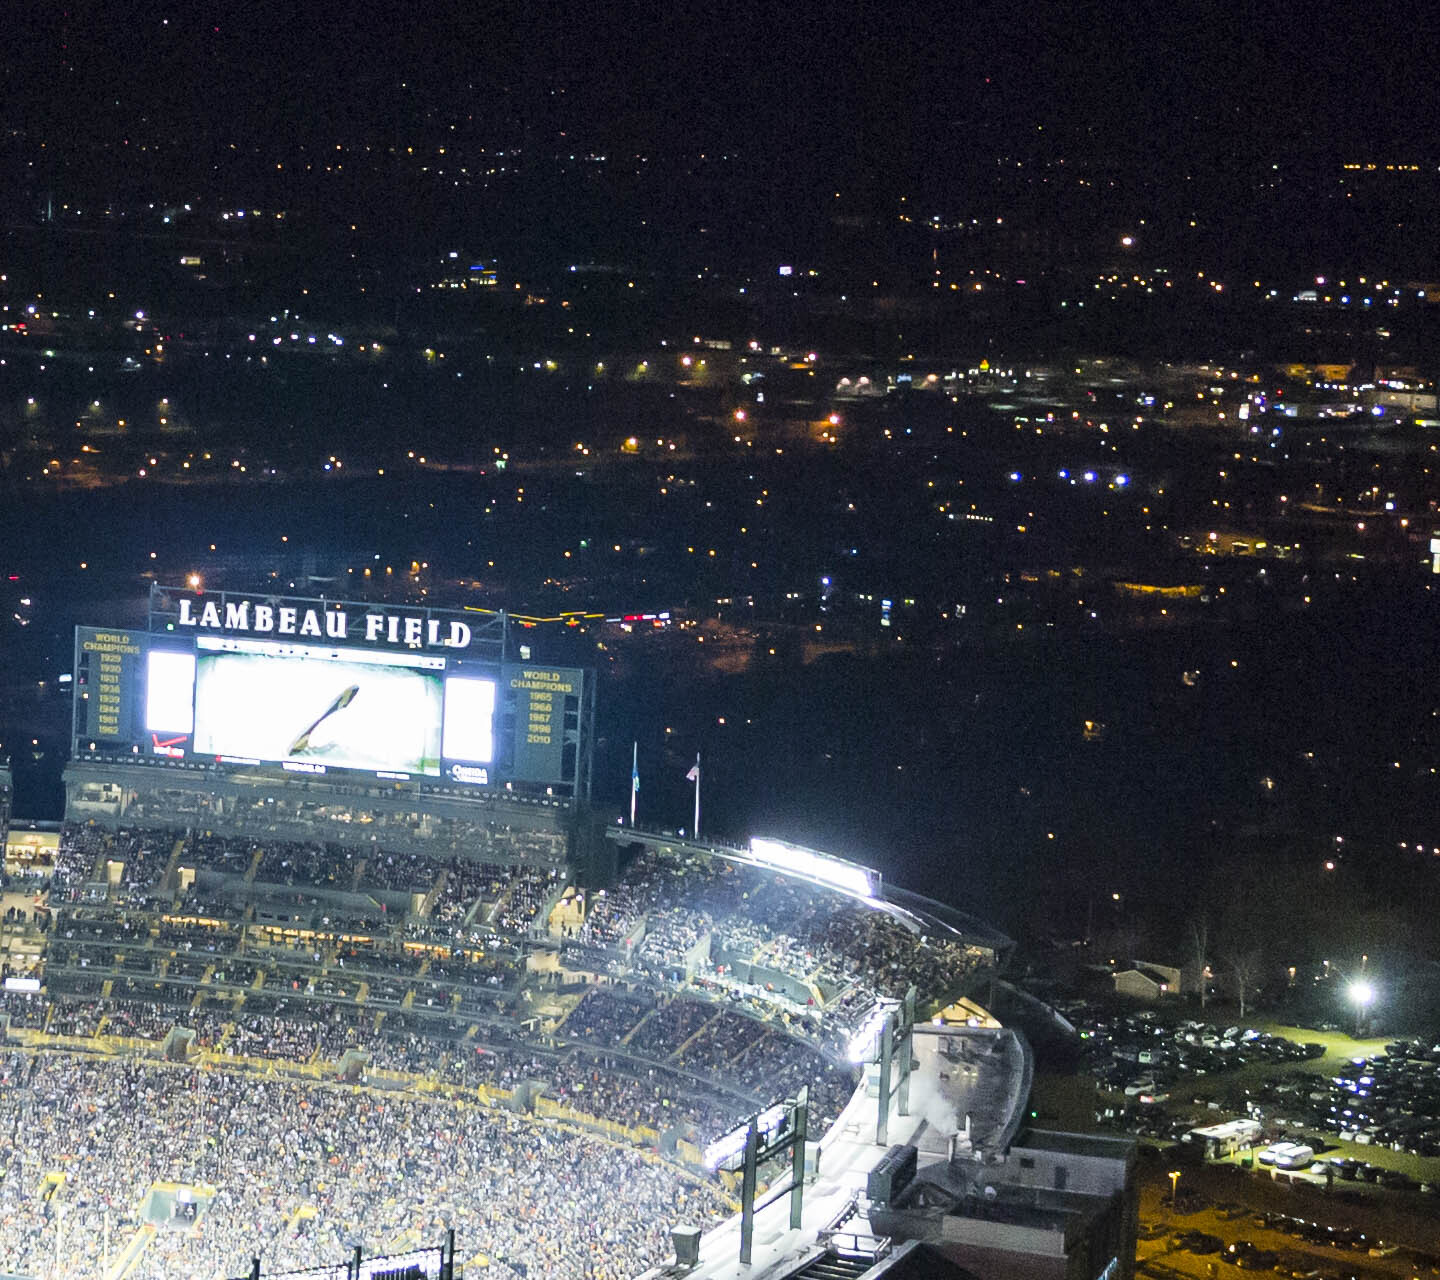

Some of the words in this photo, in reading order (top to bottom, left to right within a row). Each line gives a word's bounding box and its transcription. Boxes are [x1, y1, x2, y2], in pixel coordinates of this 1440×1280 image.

[179, 599, 347, 638] LAMBEAU
[365, 614, 471, 648] FIELD
[96, 633, 129, 644] WORLD
[83, 642, 139, 654] CHAMPIONS
[523, 671, 560, 681] WORLD
[510, 679, 572, 693] CHAMPIONS
[527, 734, 551, 744] 2010
